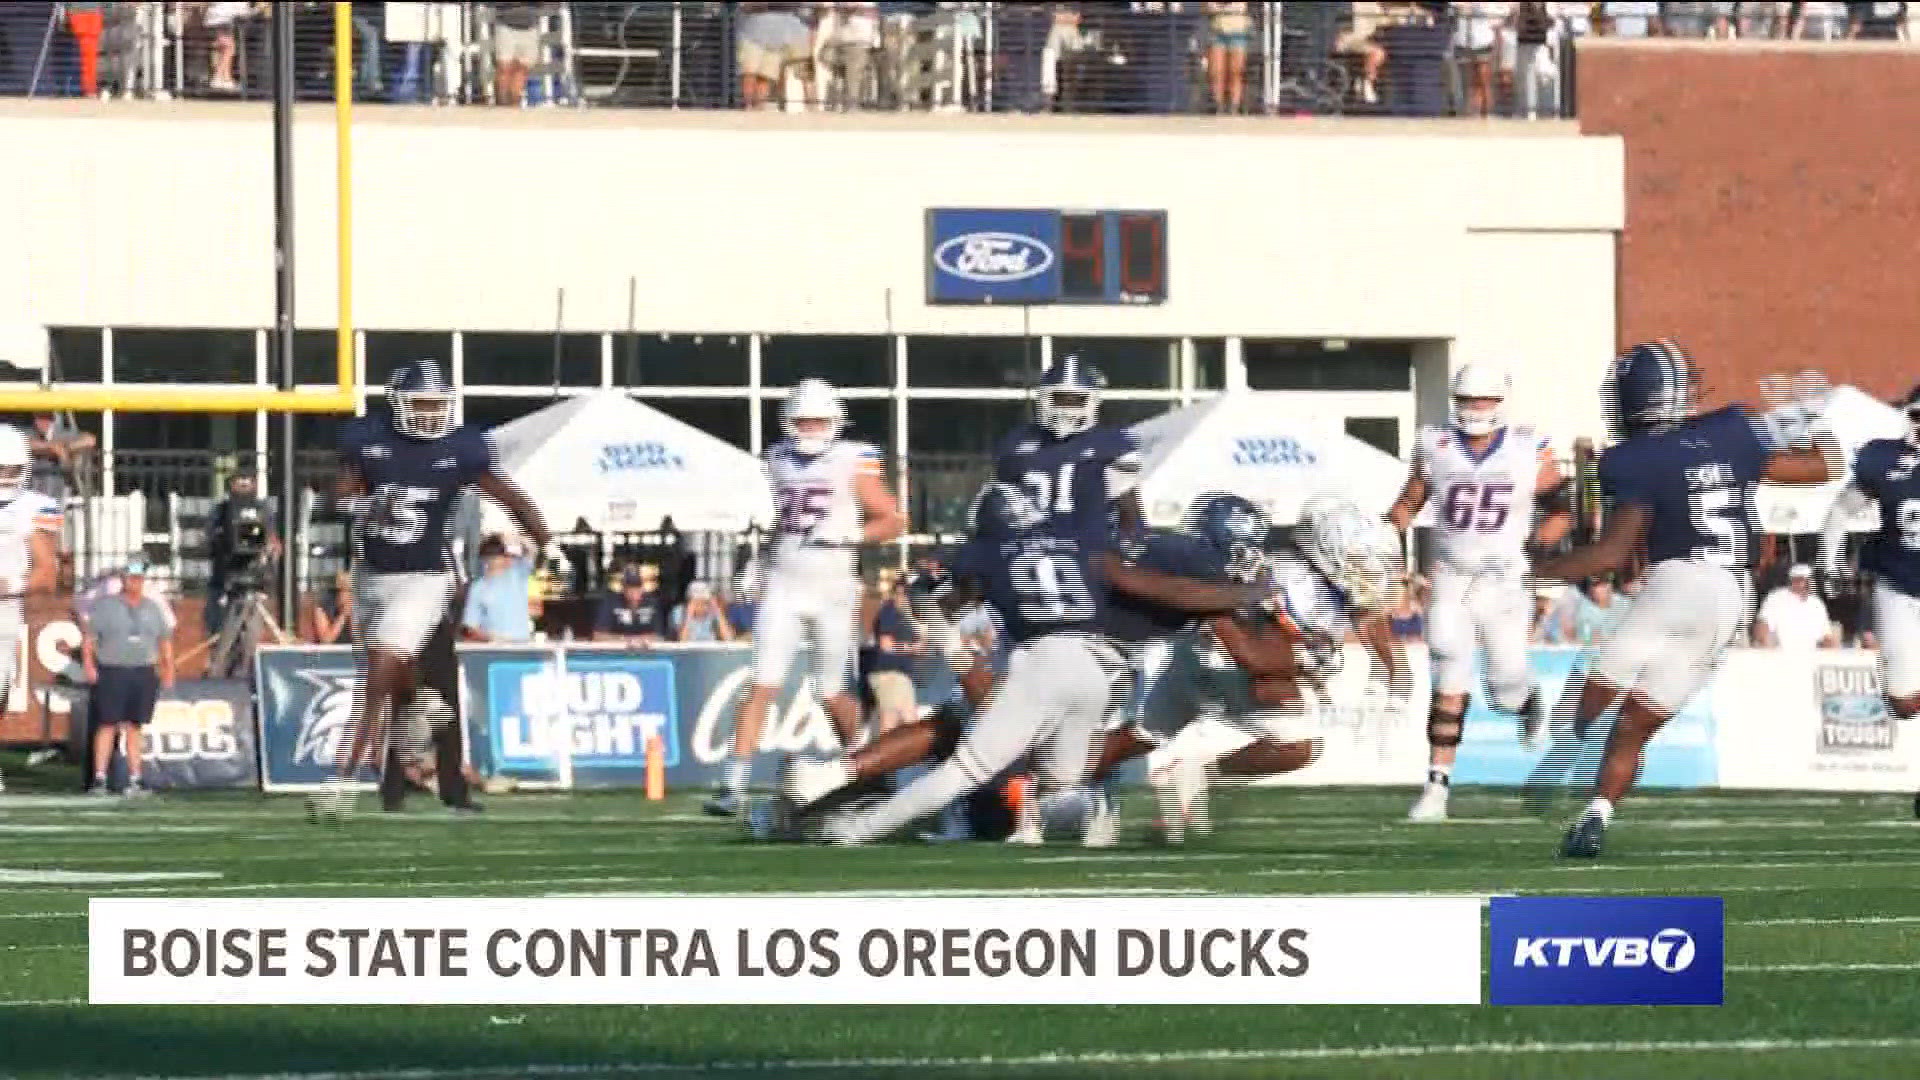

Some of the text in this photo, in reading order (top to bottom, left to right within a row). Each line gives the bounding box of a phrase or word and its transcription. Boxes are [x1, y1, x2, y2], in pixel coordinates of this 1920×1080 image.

[958, 238, 1030, 273] Ford
[1063, 213, 1163, 293] 40
[1444, 482, 1515, 531] 65
[1687, 487, 1748, 565] 5
